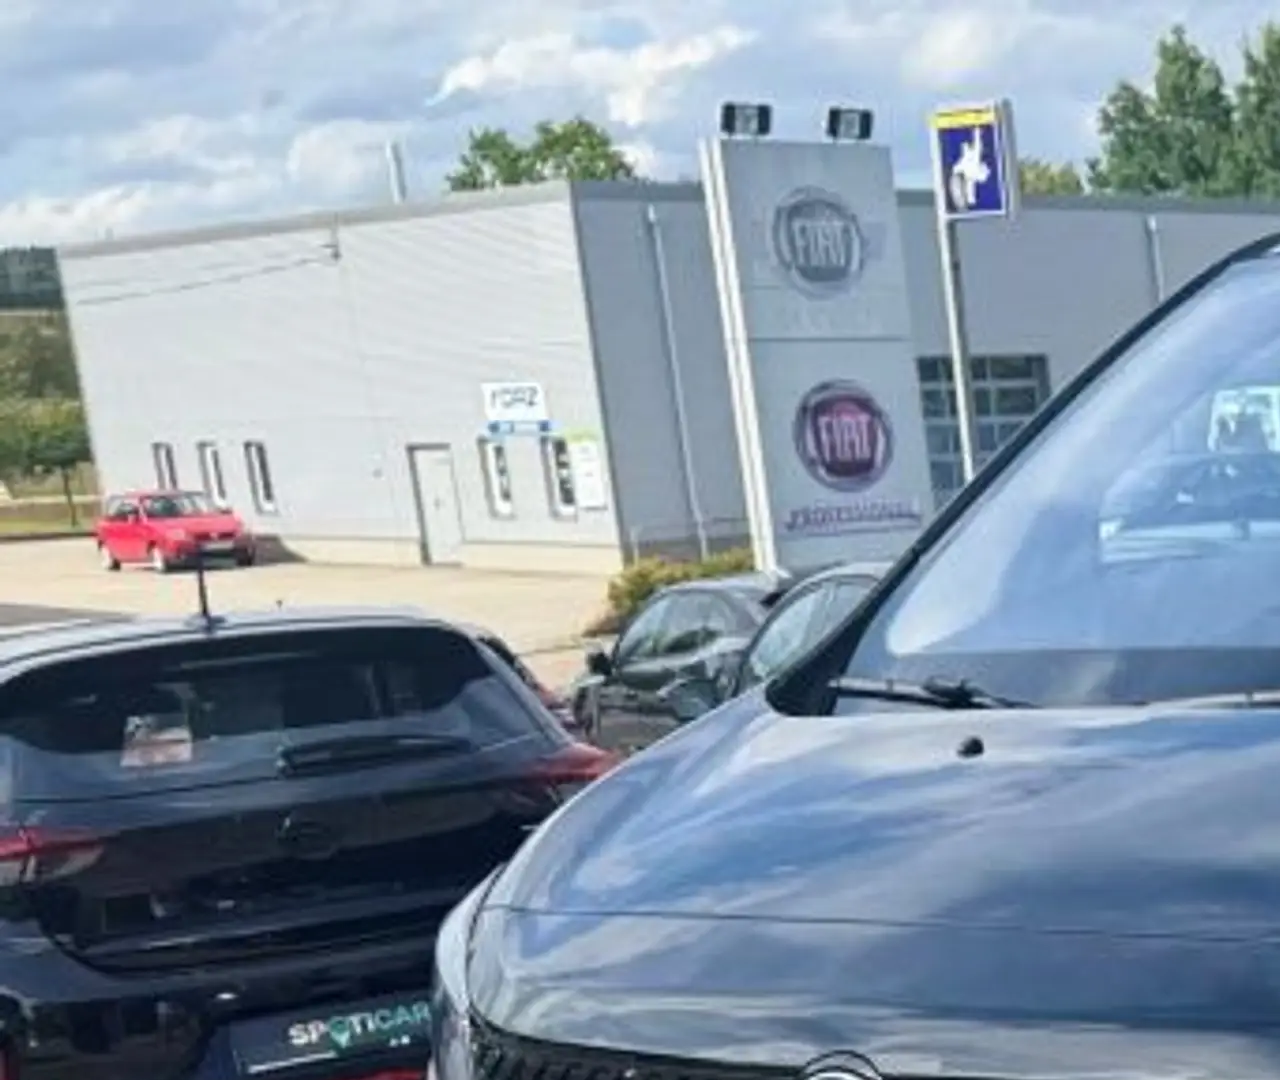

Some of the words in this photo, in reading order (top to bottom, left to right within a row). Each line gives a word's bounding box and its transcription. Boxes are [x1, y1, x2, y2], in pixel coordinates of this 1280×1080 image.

[791, 216, 848, 267] FIAT
[816, 415, 873, 462] FIAT
[287, 1001, 431, 1049] SPOTICAR
